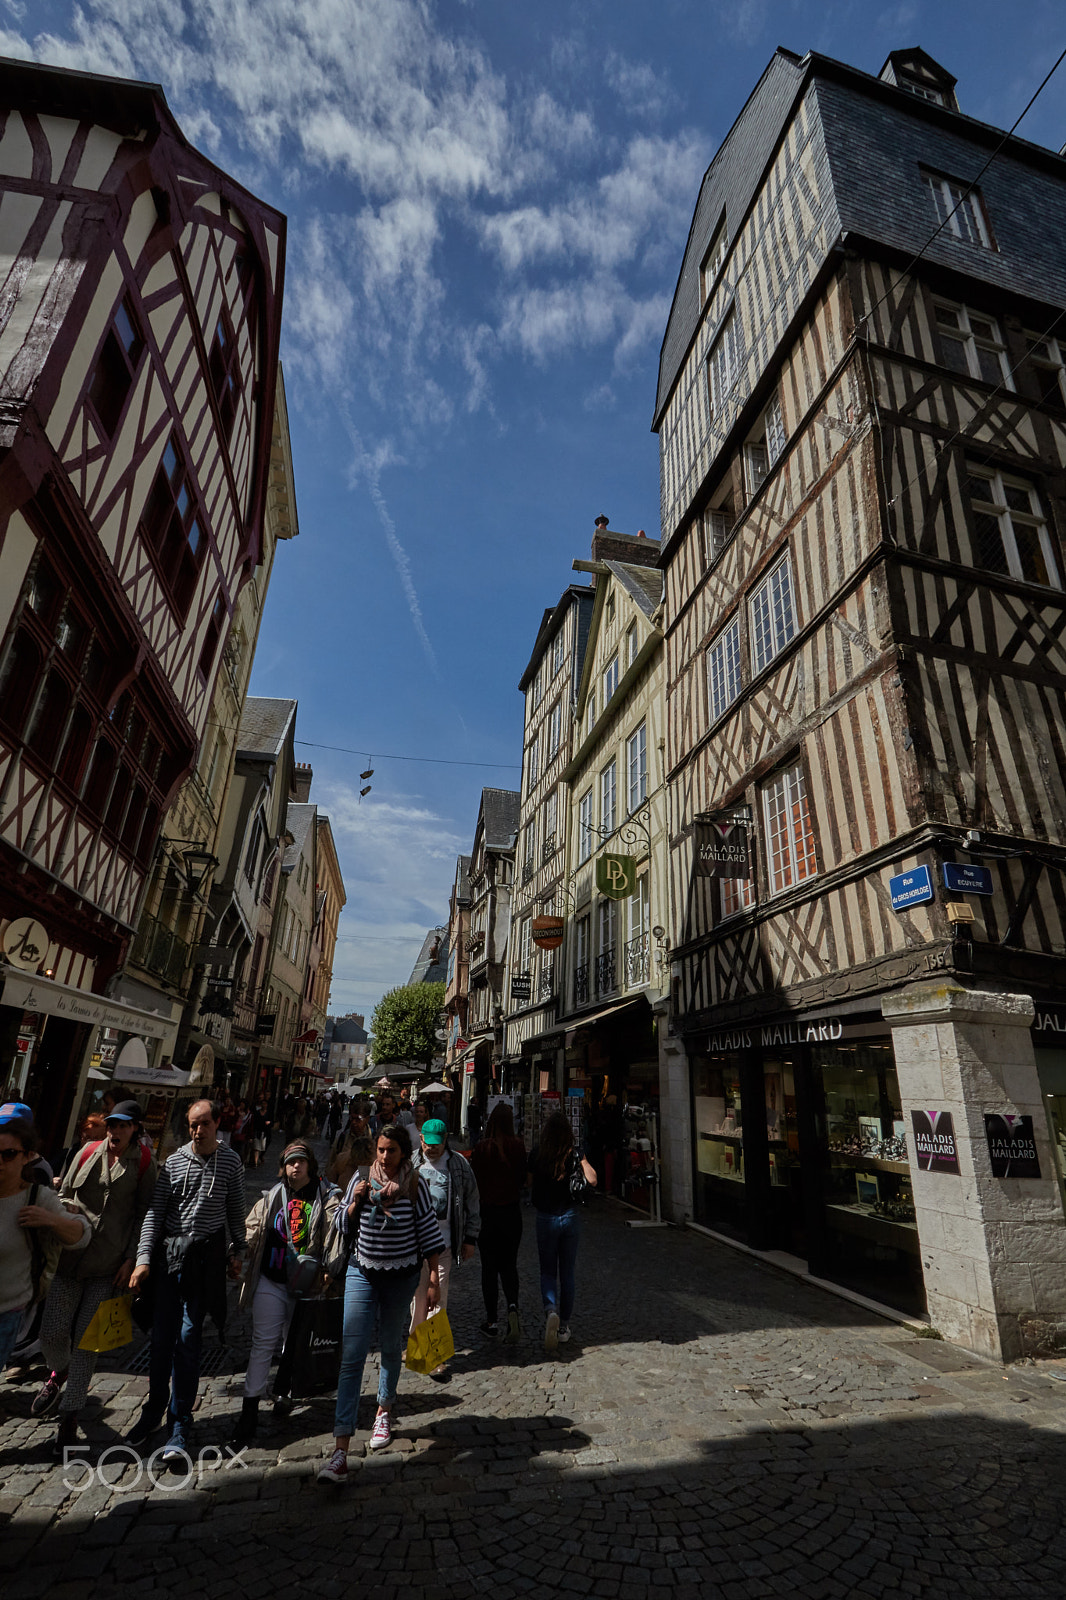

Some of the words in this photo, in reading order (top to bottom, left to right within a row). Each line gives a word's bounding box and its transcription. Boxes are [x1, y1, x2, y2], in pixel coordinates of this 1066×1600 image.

[700, 844, 746, 854] JALADIS
[700, 852, 746, 862] MAILLARD
[963, 869, 975, 877] Rue
[902, 877, 914, 886] Rue
[898, 891, 910, 902] GROS
[909, 885, 930, 898] HORLOGE
[512, 981, 531, 989] LUSH
[706, 1029, 752, 1052] JALADIS
[761, 1016, 843, 1047] MAILLARD
[917, 1133, 954, 1145] JALADIS
[991, 1138, 1035, 1149] JALADIS
[917, 1142, 955, 1155] MAILLARD
[992, 1149, 1036, 1159] MAILLARD
